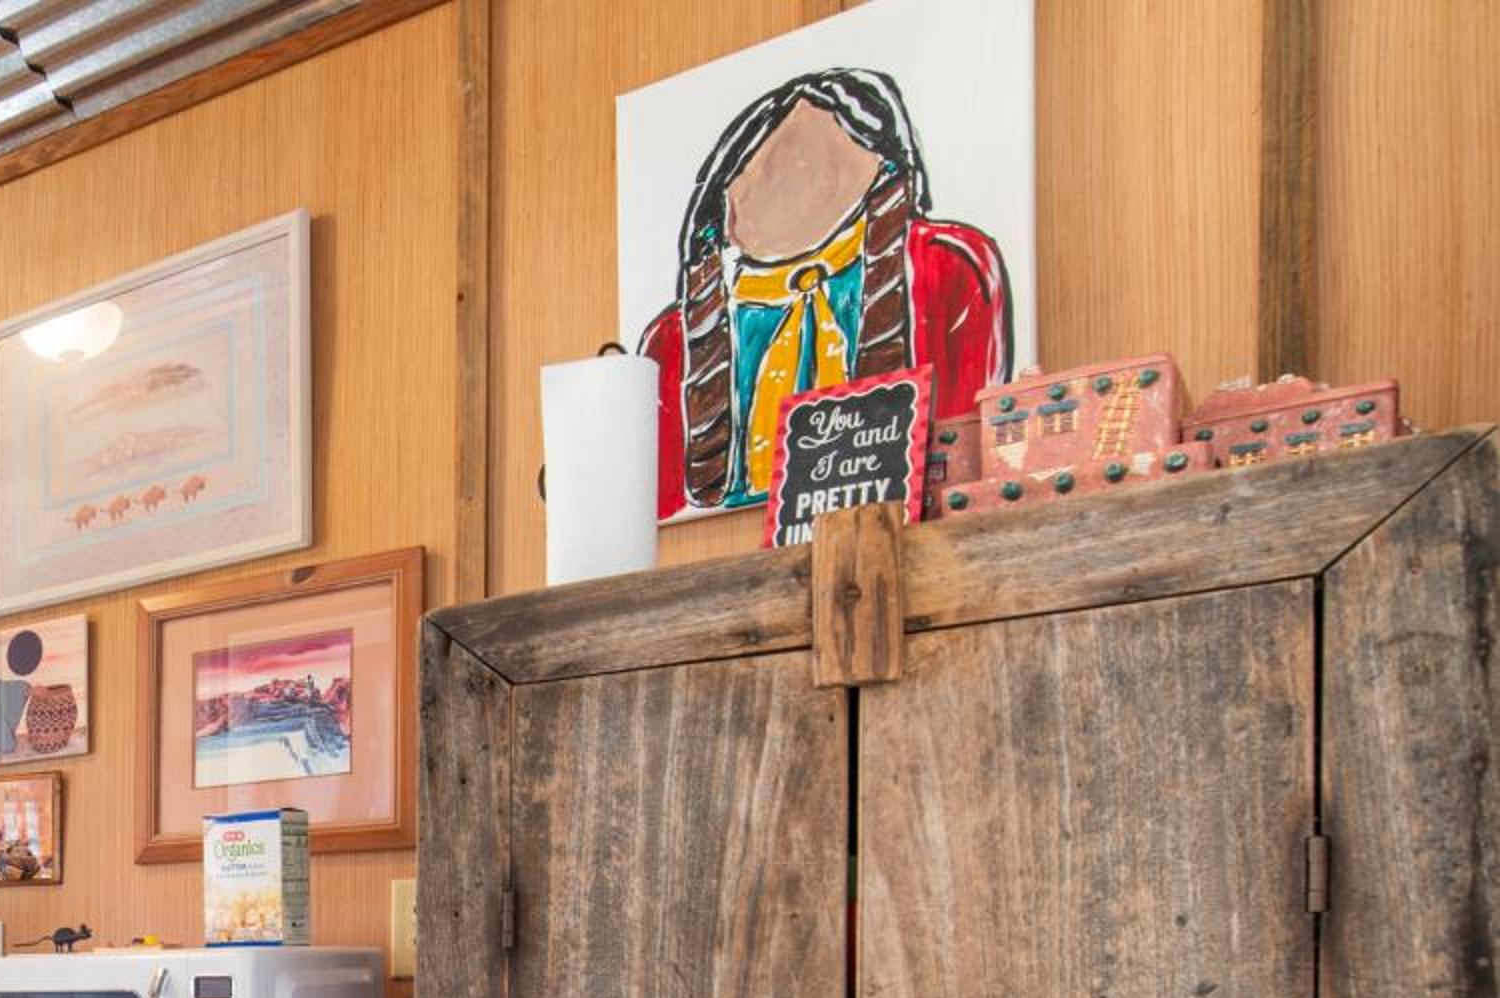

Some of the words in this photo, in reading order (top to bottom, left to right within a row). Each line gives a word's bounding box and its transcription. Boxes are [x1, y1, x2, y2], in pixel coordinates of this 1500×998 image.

[798, 406, 864, 449] You
[853, 416, 902, 447] and
[839, 454, 883, 476] are
[795, 477, 892, 519] PRETTY
